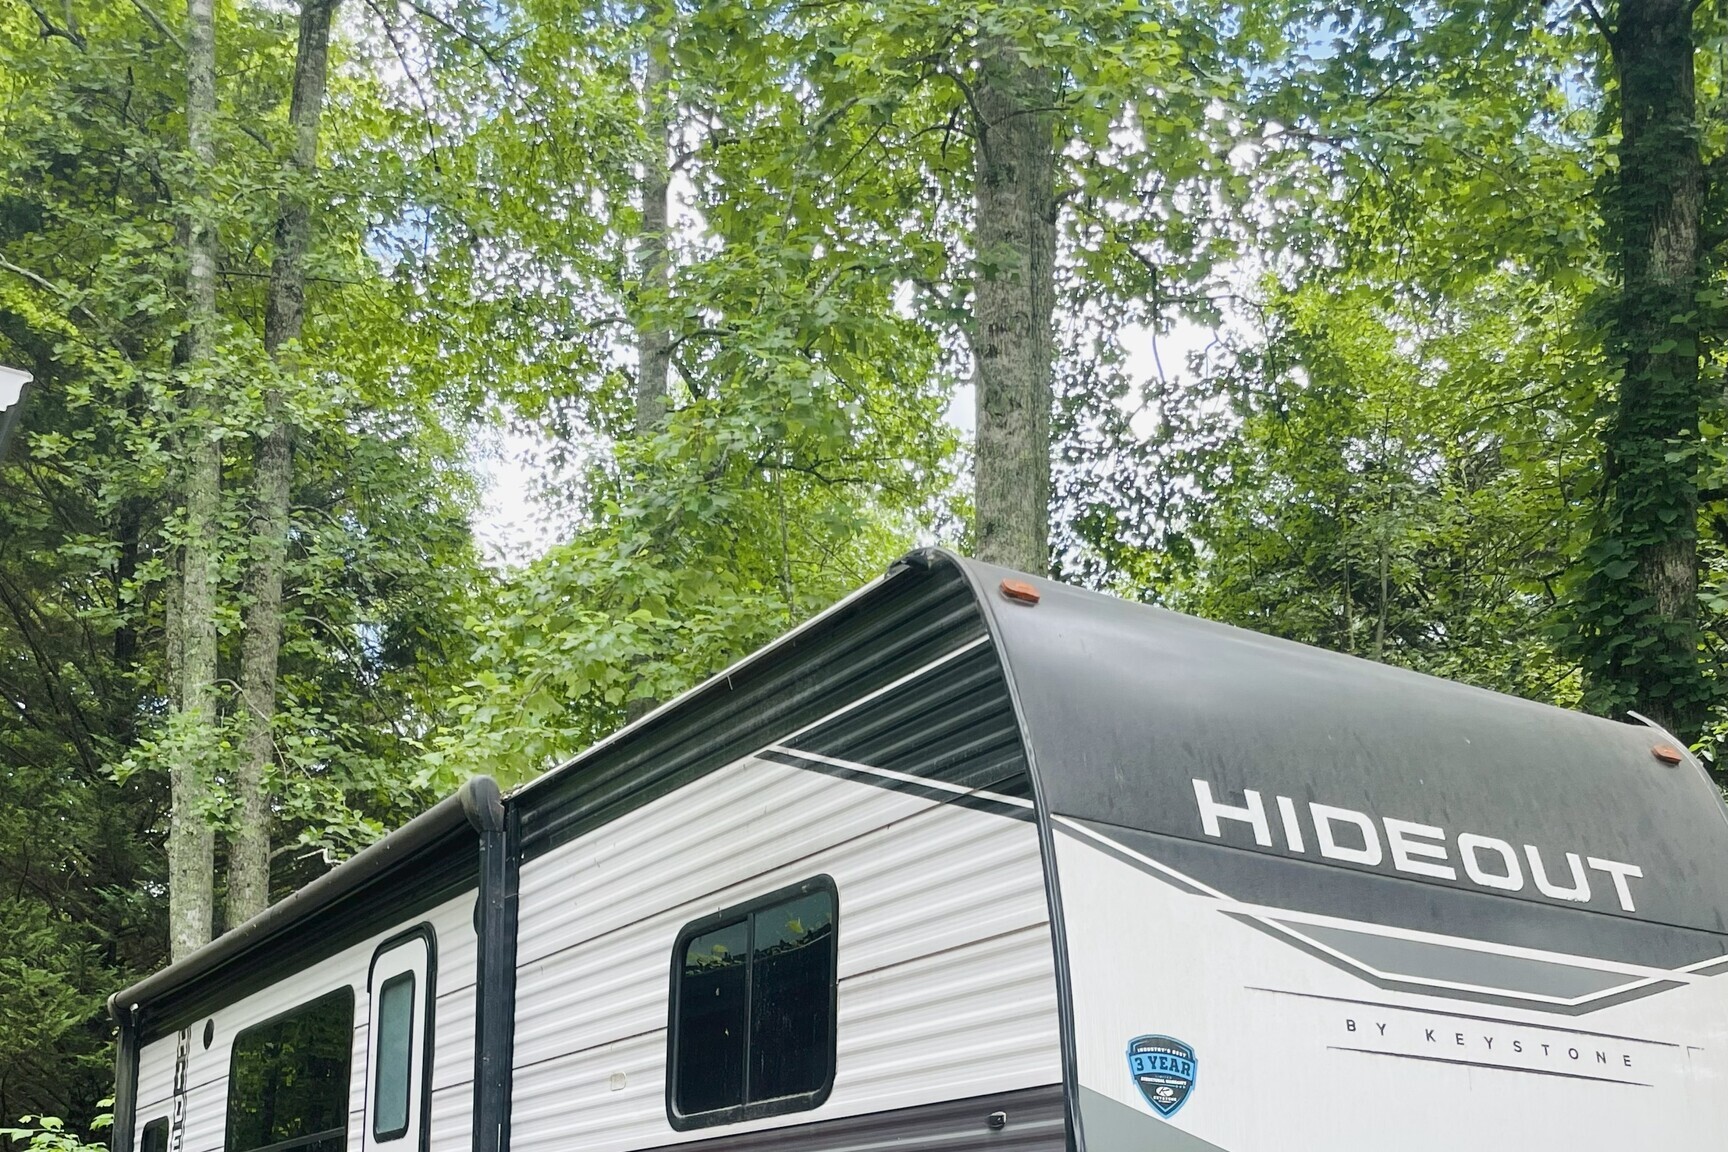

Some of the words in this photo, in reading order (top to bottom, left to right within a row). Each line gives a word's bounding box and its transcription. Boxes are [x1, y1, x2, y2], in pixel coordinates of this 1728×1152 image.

[1192, 778, 1643, 912] HIDEOUT
[1135, 1057, 1144, 1071] 3
[1148, 1056, 1190, 1076] YEAR
[1346, 1018, 1387, 1036] BY
[1425, 1028, 1632, 1067] KEYSTONE
